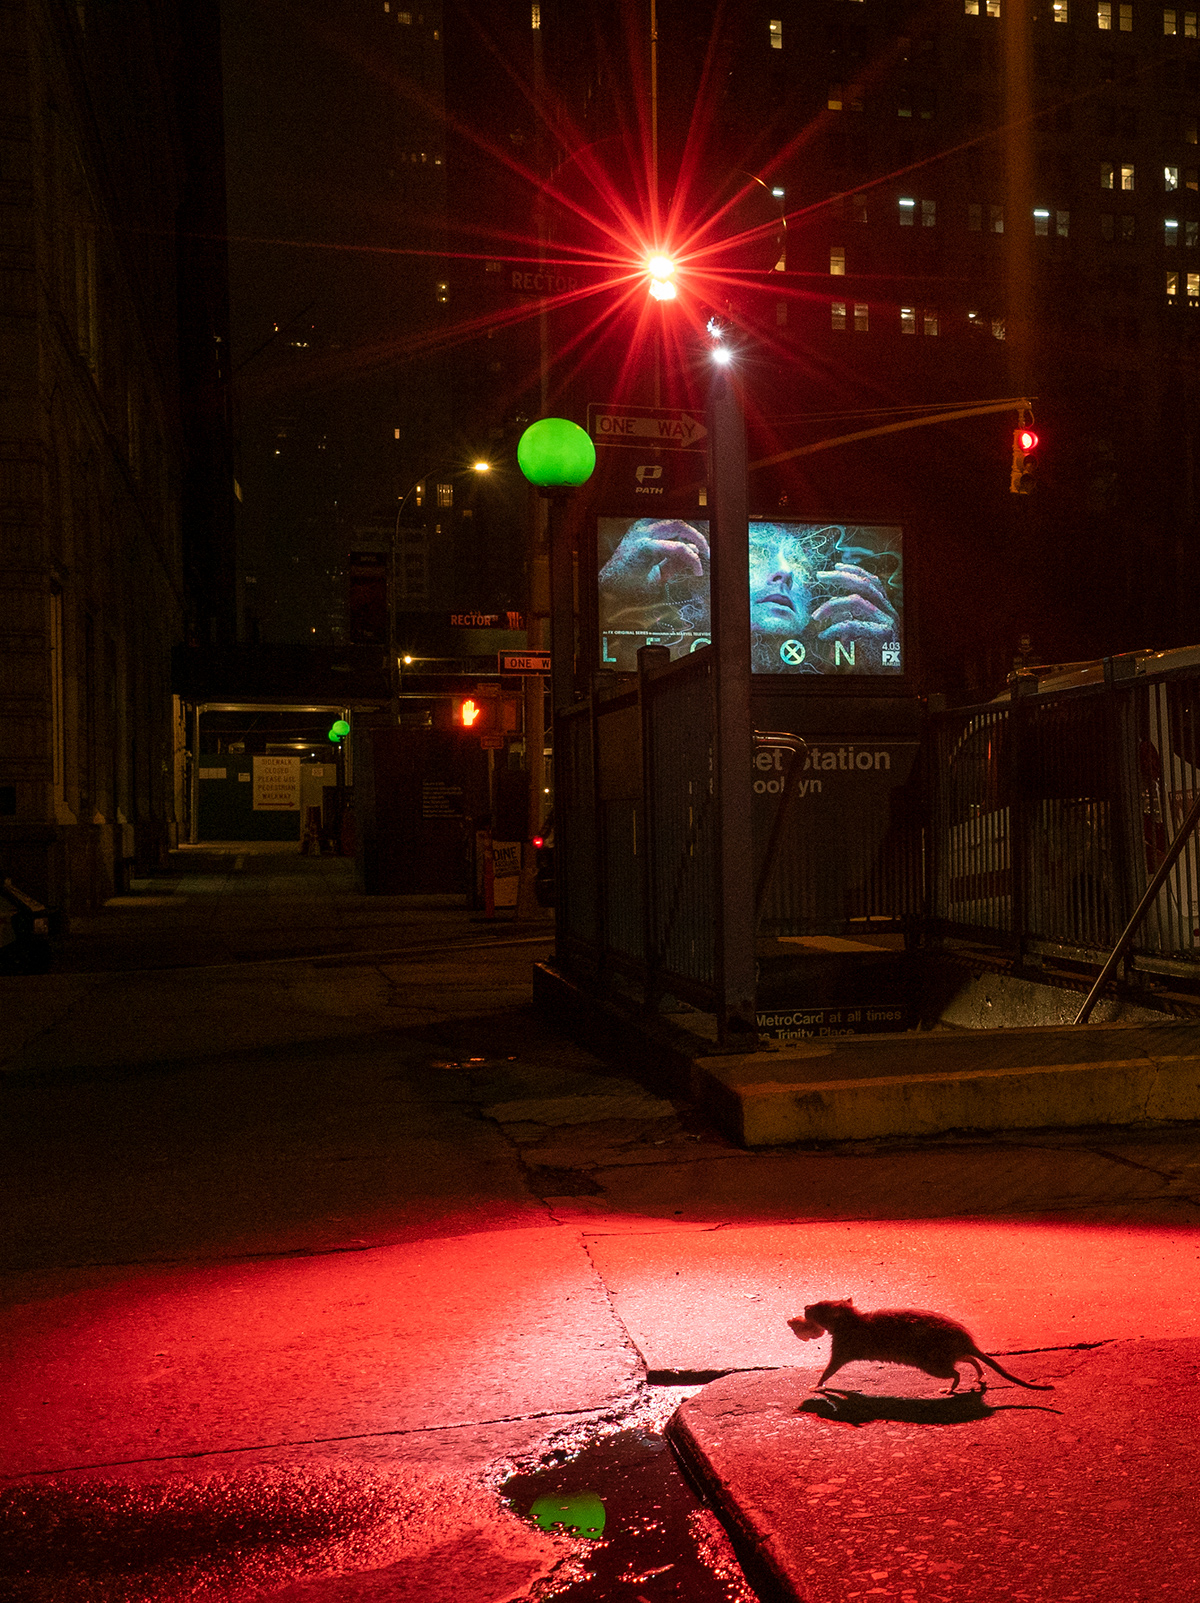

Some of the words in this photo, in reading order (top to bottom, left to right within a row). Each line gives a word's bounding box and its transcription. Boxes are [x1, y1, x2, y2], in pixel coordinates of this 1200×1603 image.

[512, 271, 578, 292] RECTOR
[601, 418, 637, 435] ONE
[658, 420, 697, 438] WAY
[450, 614, 491, 626] RECTOR
[882, 641, 901, 651] 4.03
[882, 651, 901, 662] FX
[510, 658, 532, 668] ONE
[492, 846, 517, 861] DINE
[756, 1010, 824, 1027] MetroCard
[829, 1011, 842, 1024] at
[847, 1010, 862, 1023] all
[866, 1009, 902, 1022] times
[775, 1028, 815, 1039] Trinity
[819, 1027, 855, 1038] Place
